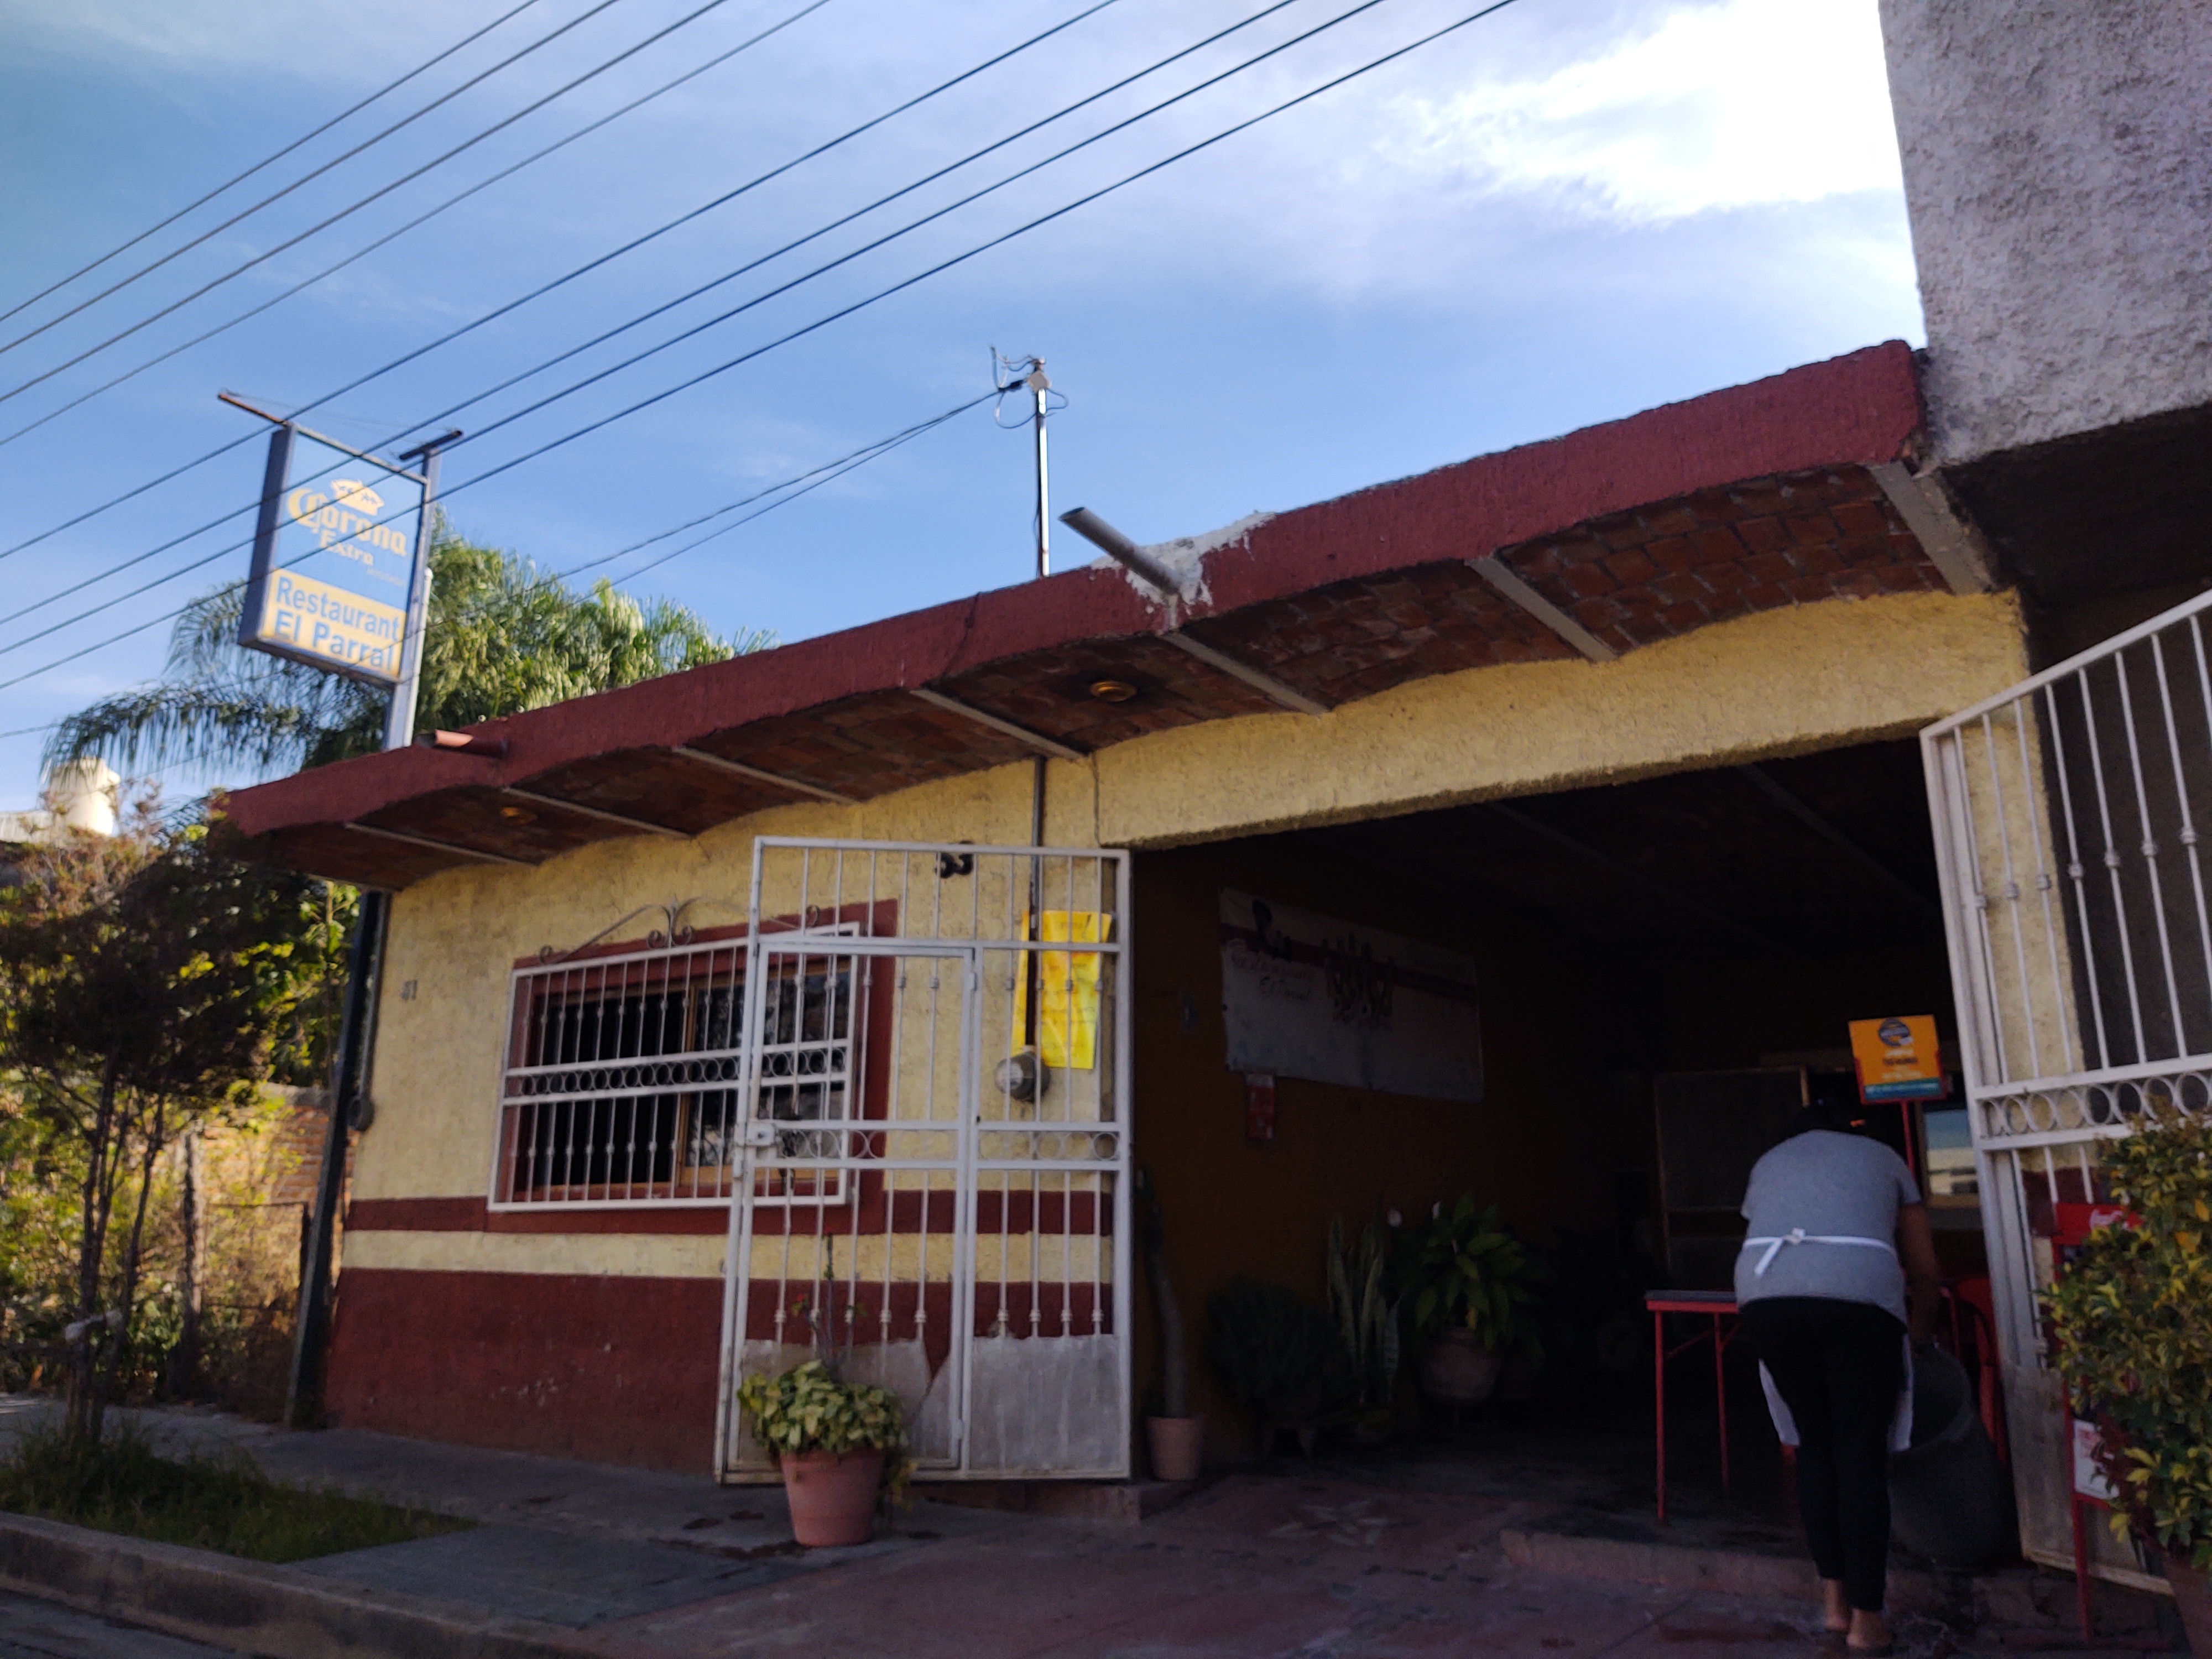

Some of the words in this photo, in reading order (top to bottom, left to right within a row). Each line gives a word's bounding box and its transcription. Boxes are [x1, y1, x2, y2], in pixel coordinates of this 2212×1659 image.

[287, 488, 408, 557] Corona
[319, 530, 374, 566] Extra
[273, 609, 302, 642] El
[312, 622, 394, 671] Parral
[276, 576, 400, 643] Restaurant
